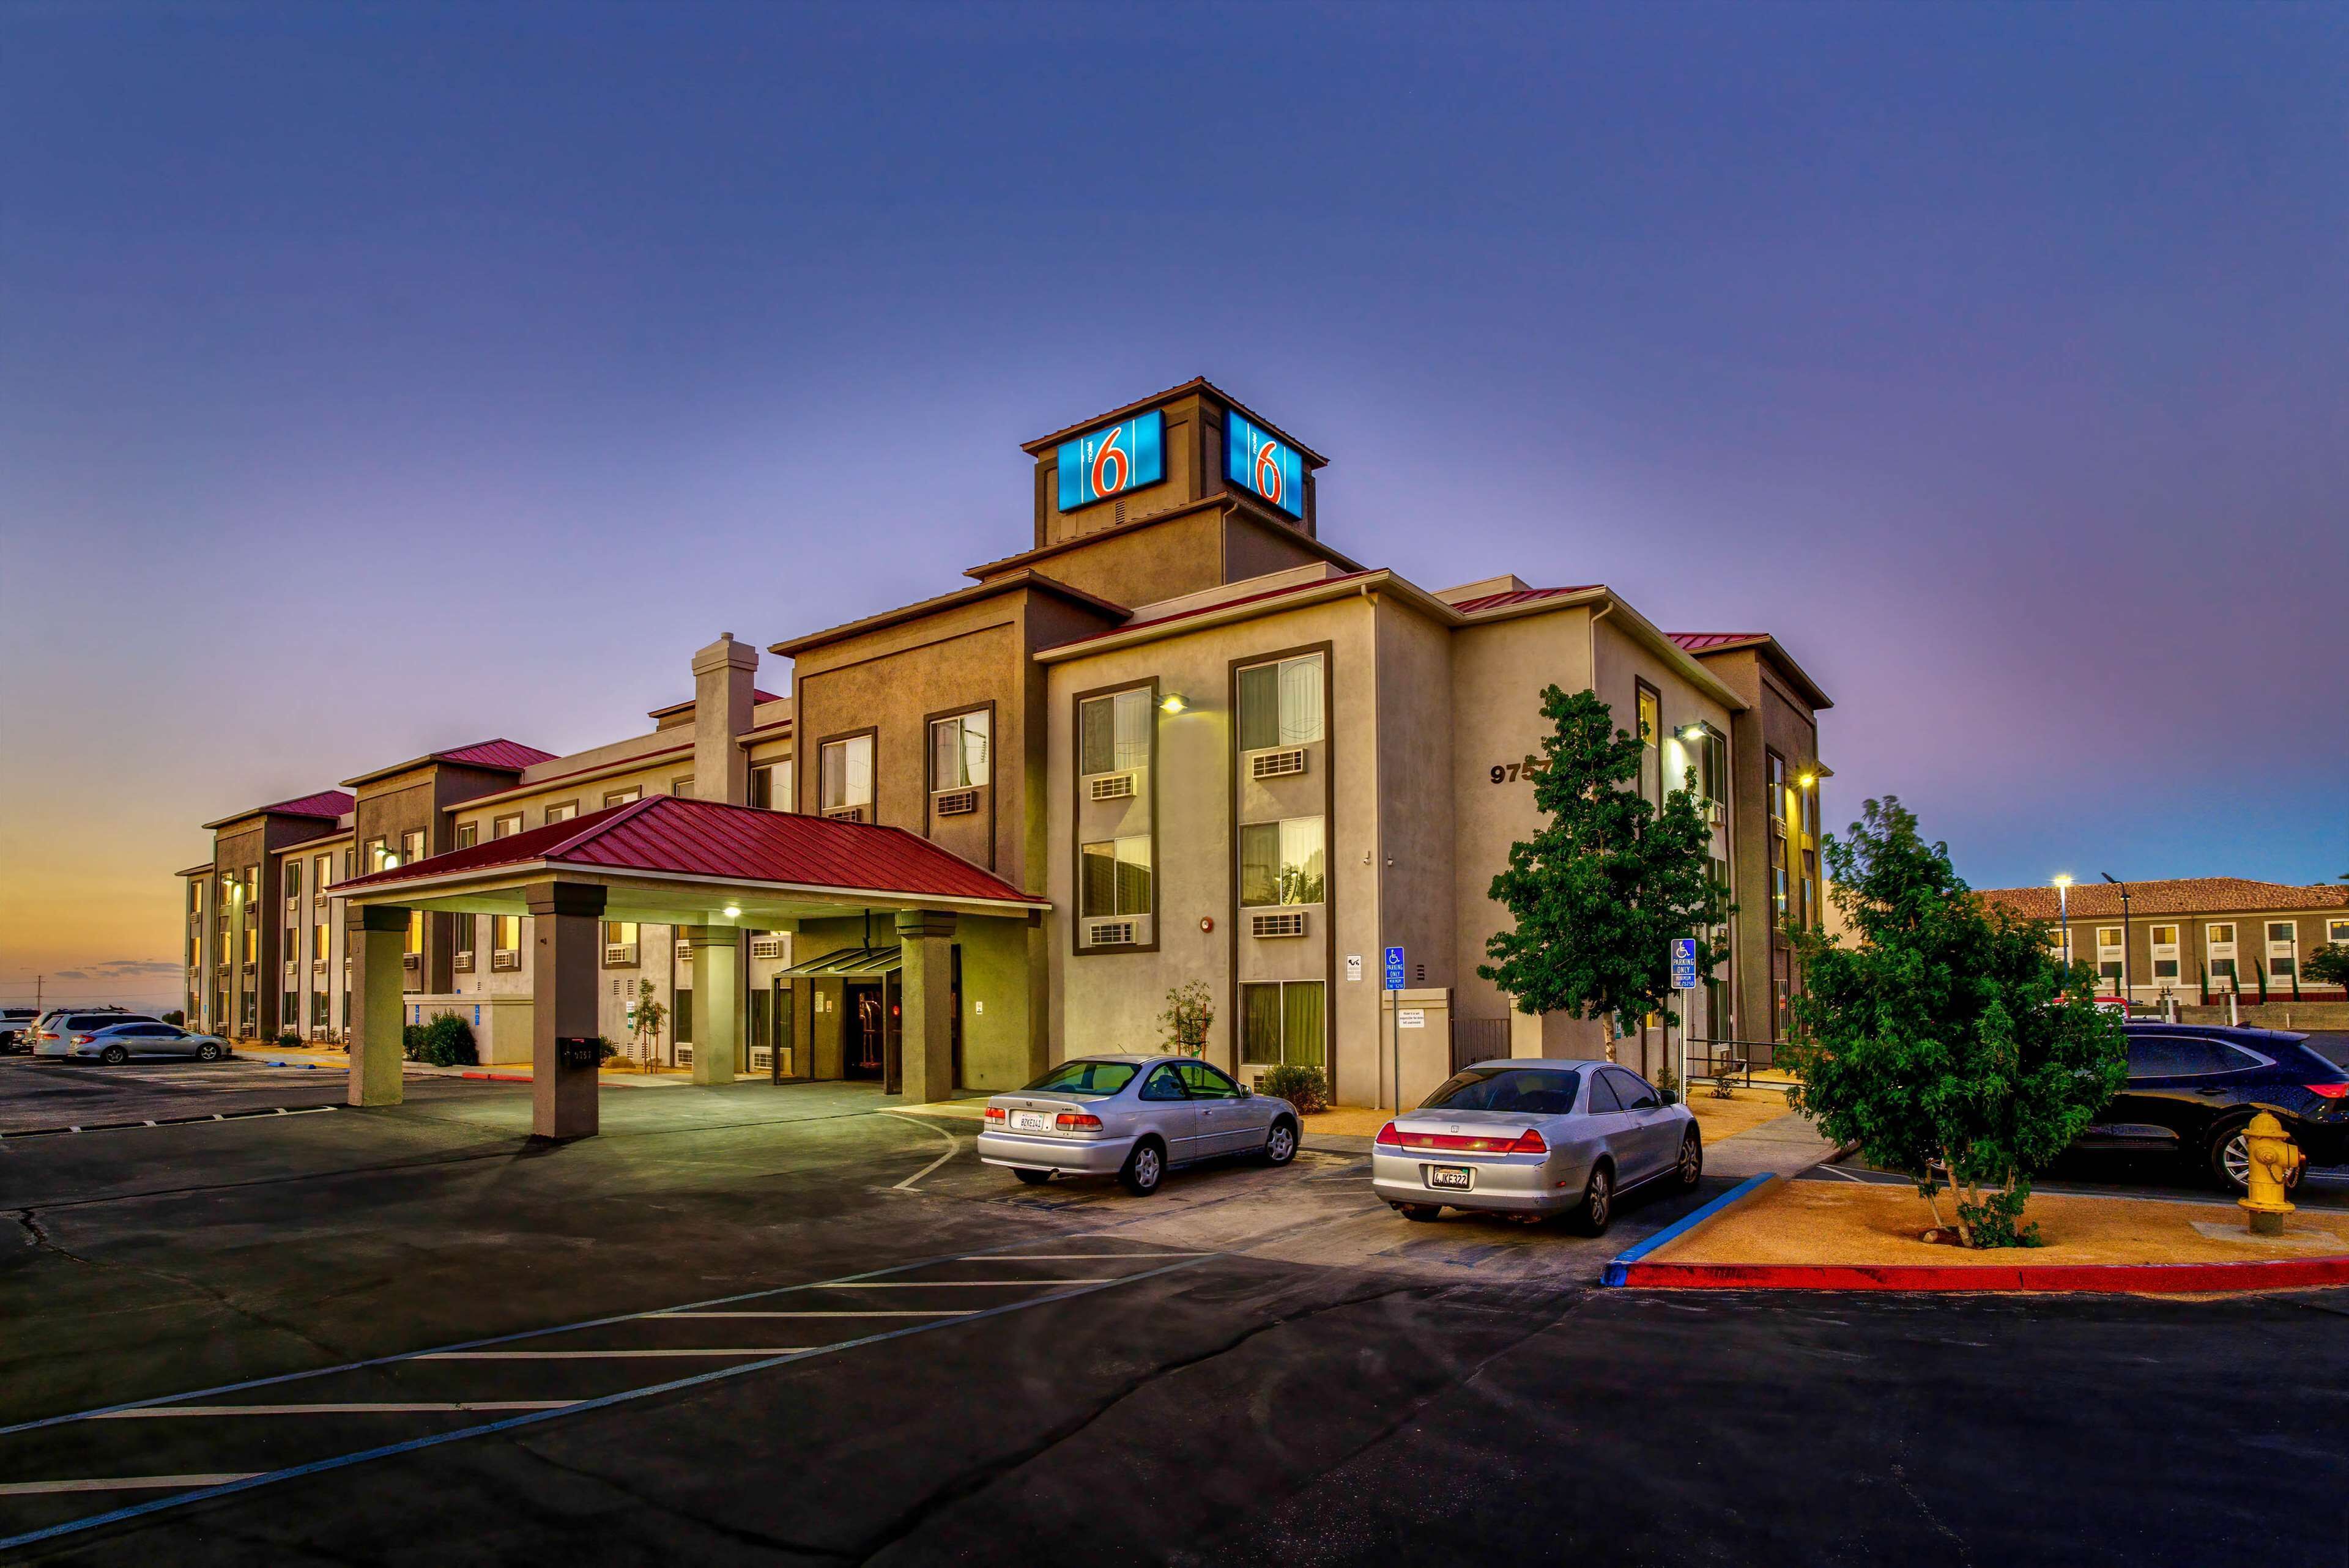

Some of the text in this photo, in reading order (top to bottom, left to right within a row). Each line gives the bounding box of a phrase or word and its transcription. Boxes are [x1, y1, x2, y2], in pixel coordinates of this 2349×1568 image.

[1091, 427, 1129, 498] 6
[1255, 441, 1282, 505] 6
[1434, 1172, 1467, 1185] 4JKE322
